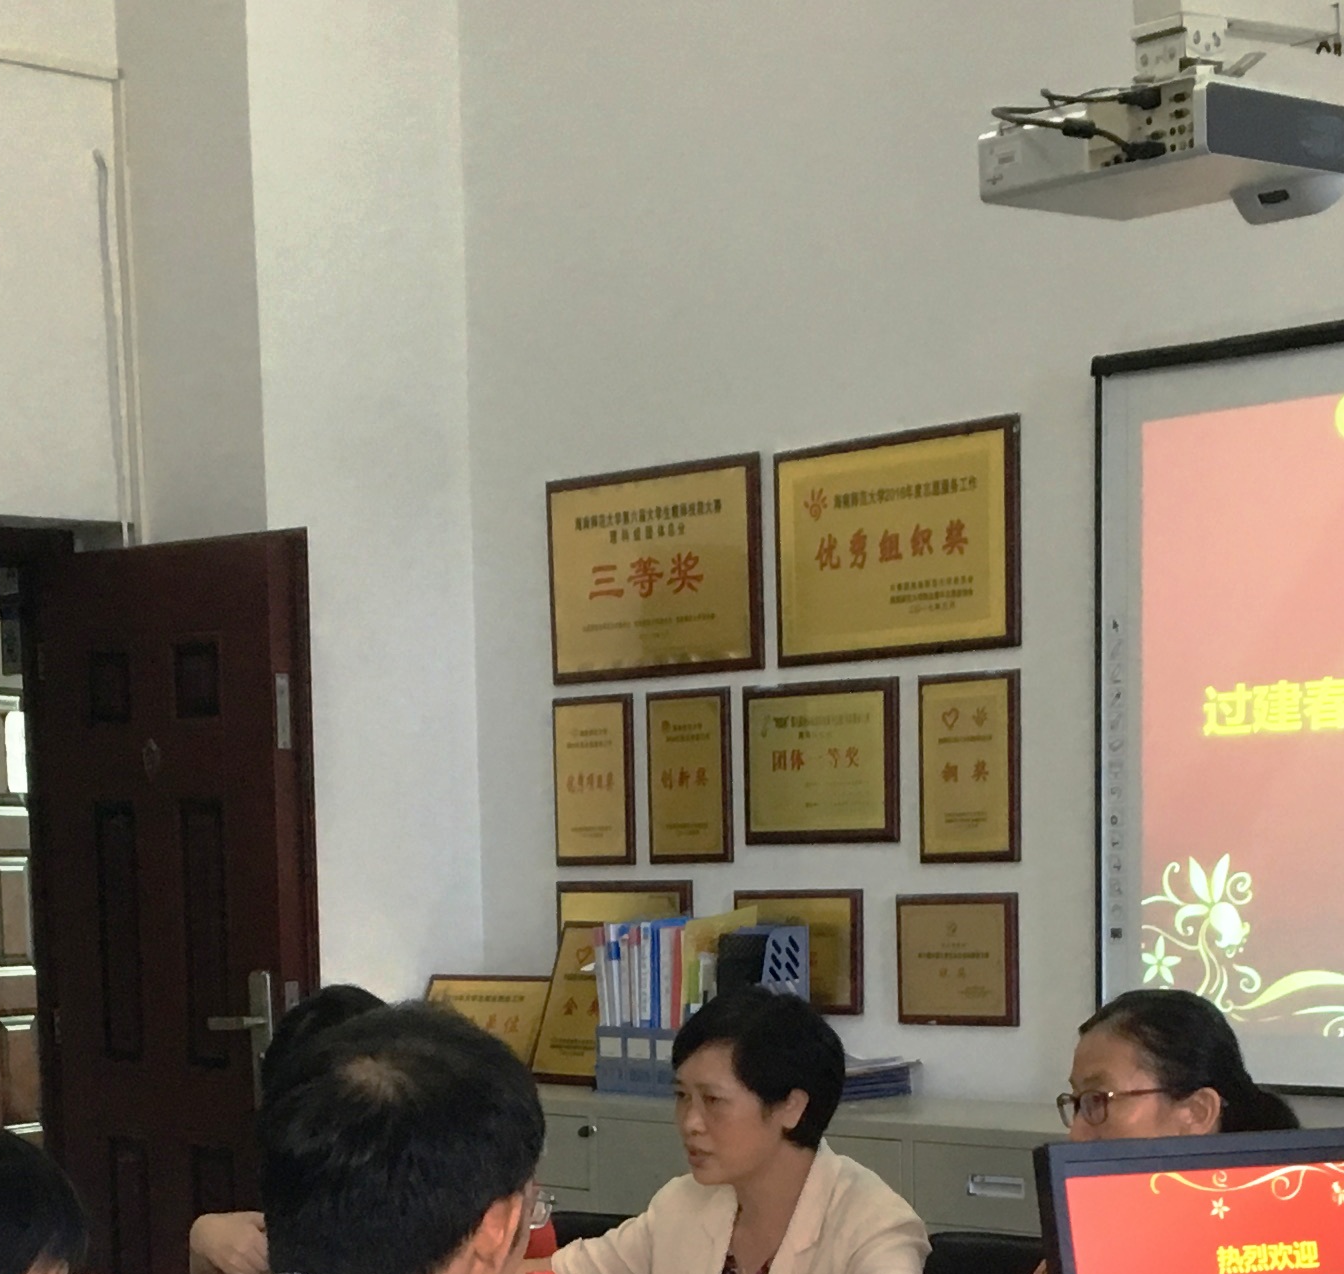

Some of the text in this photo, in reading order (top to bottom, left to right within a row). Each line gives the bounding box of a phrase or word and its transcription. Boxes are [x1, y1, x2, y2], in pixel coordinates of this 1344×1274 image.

[814, 518, 969, 572] 优秀组织奖
[588, 550, 704, 601] 三等奖
